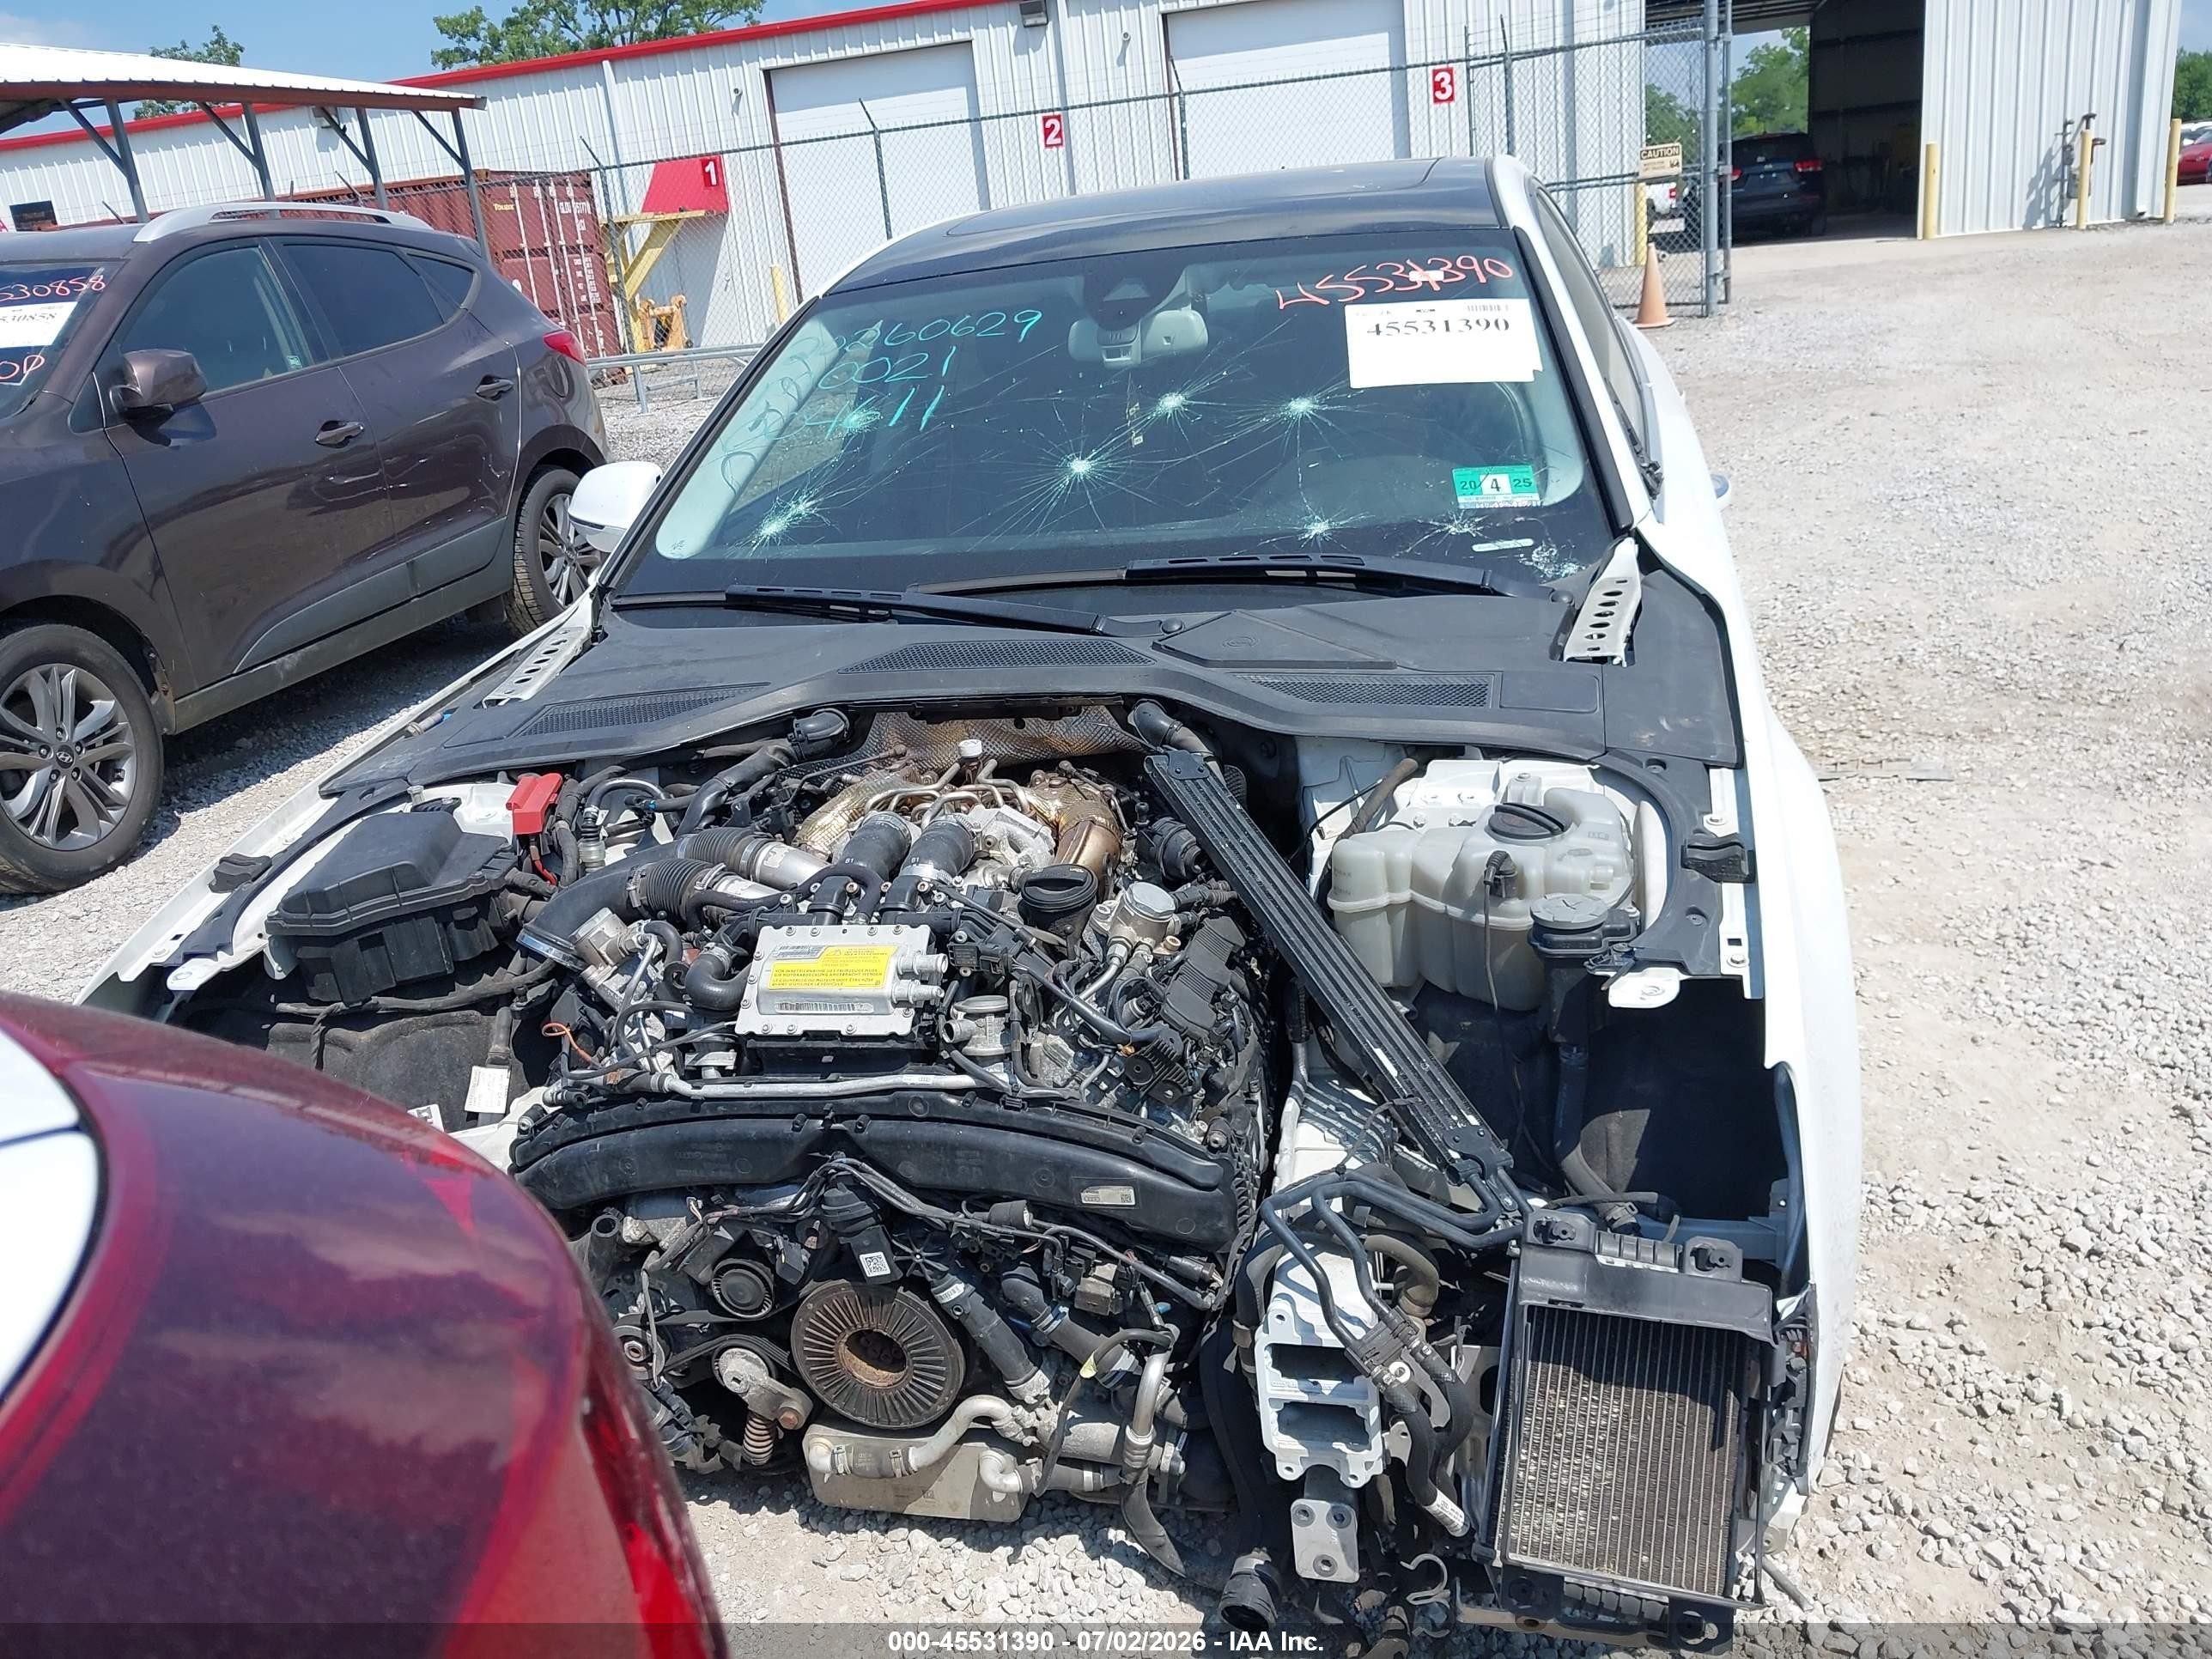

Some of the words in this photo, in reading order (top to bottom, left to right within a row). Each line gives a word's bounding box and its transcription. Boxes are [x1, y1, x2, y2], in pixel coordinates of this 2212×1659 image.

[1435, 71, 1453, 100] 3
[1045, 118, 1060, 145] 2
[1641, 146, 1679, 159] CAUTION
[705, 161, 717, 185] 1
[1367, 317, 1510, 337] 45531390
[1460, 480, 1477, 490] 20
[1491, 478, 1501, 492] 4
[1513, 477, 1533, 488] 25
